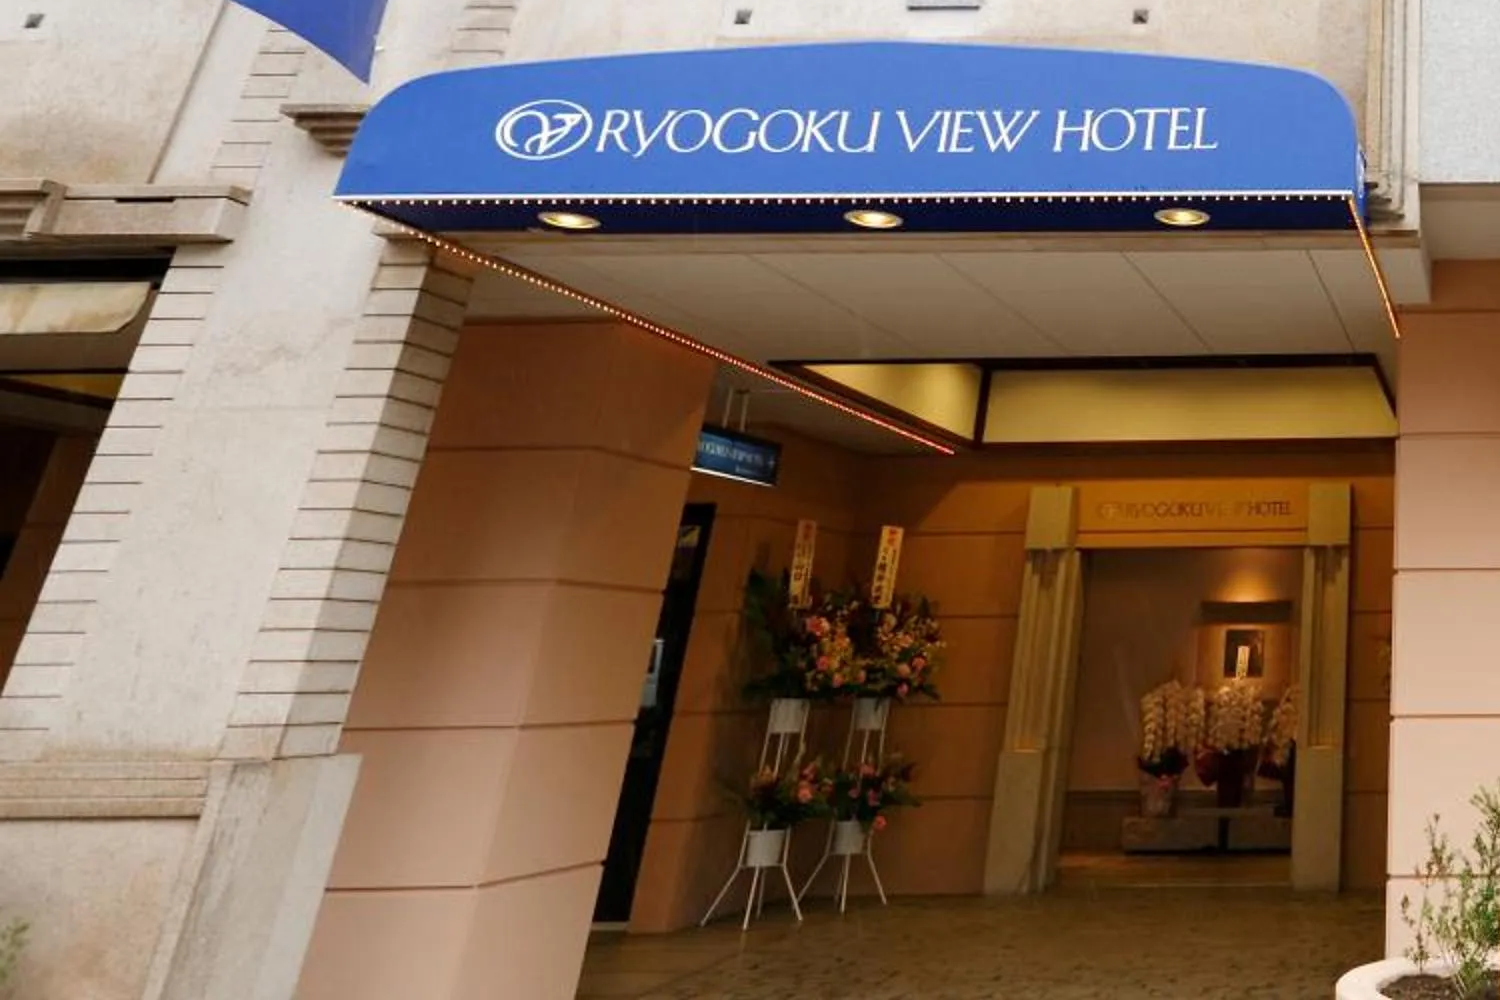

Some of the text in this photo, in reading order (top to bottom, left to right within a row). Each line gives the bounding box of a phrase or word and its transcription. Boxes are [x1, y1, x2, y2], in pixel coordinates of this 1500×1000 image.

[596, 107, 1218, 158] RYOGOKU VIEW HOTEL
[1246, 500, 1293, 517] HOTEL
